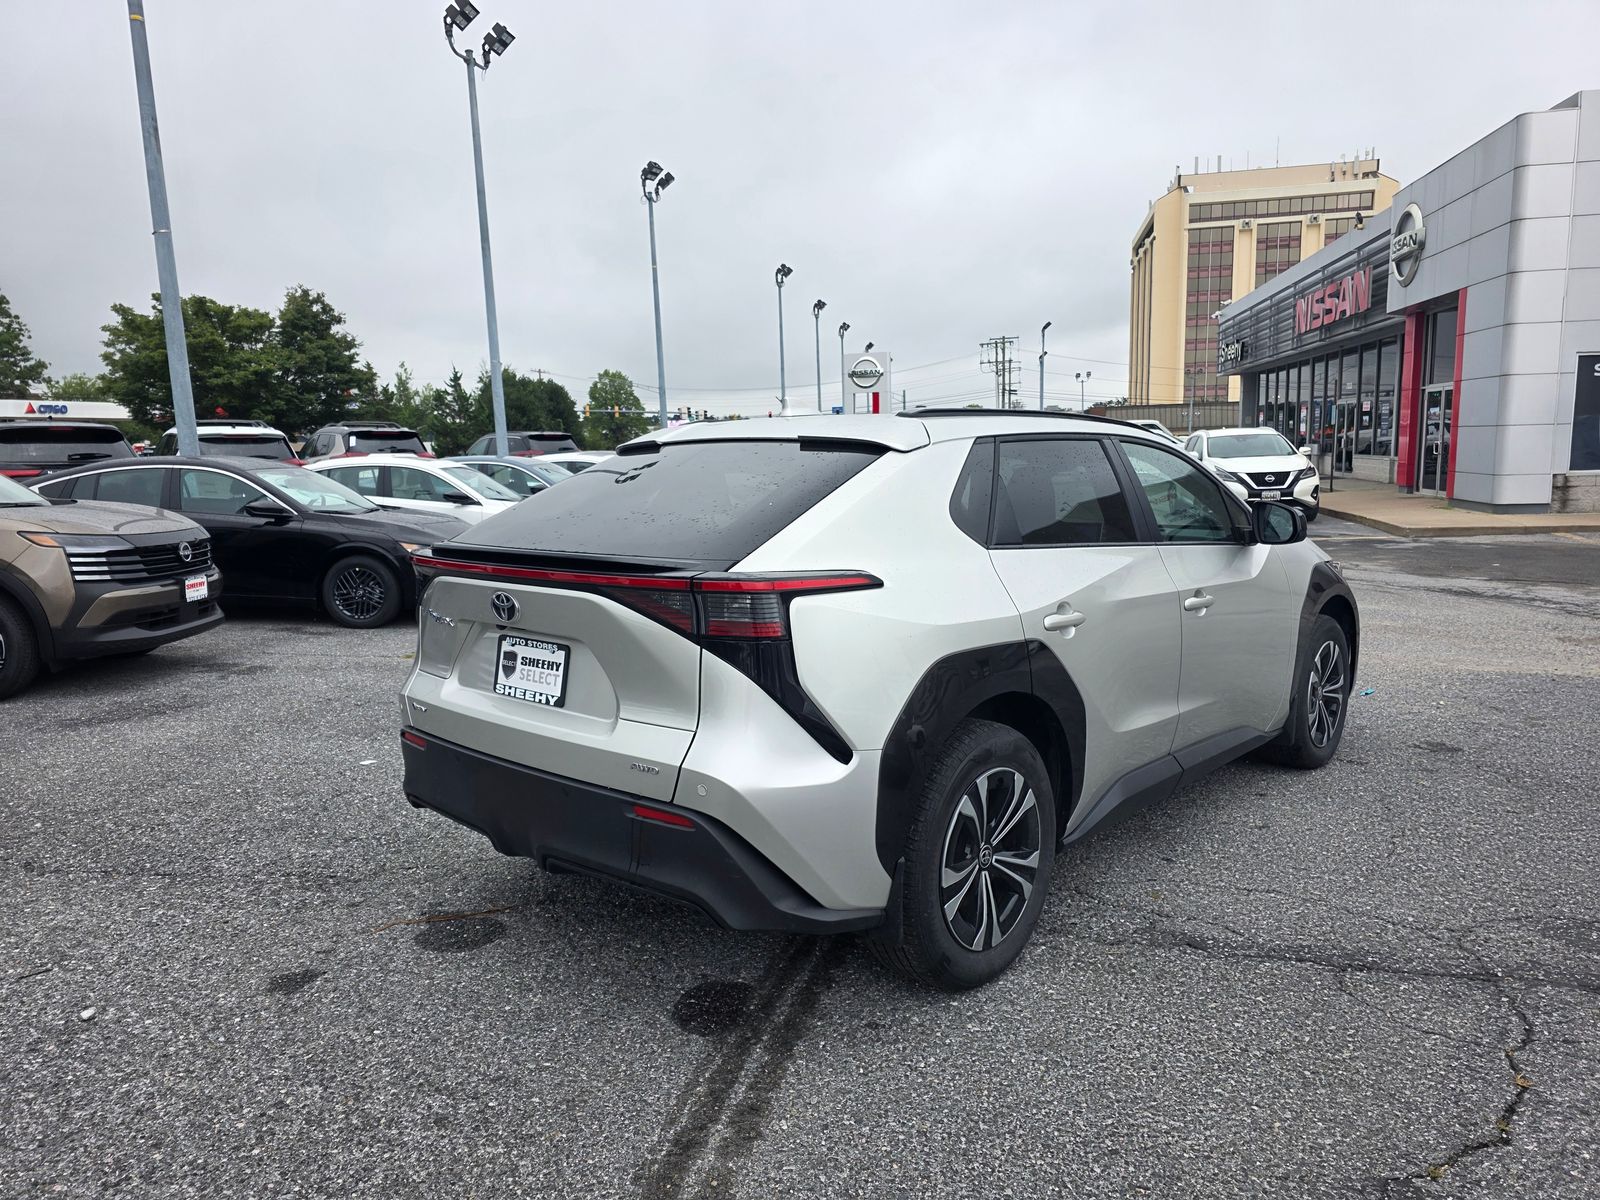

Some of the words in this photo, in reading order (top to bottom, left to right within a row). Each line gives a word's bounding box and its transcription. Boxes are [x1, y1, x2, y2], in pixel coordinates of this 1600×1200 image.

[1391, 231, 1419, 256] SSAN
[1295, 265, 1373, 337] NISSAN
[1221, 339, 1242, 363] Sheehy
[38, 404, 68, 415] CITGO
[185, 581, 205, 590] SHEEHY
[505, 636, 526, 646] AUTO
[527, 640, 558, 652] STORES
[520, 656, 562, 672] SHEEHY
[519, 668, 560, 686] SELECT
[495, 683, 559, 706] SHEEHY
